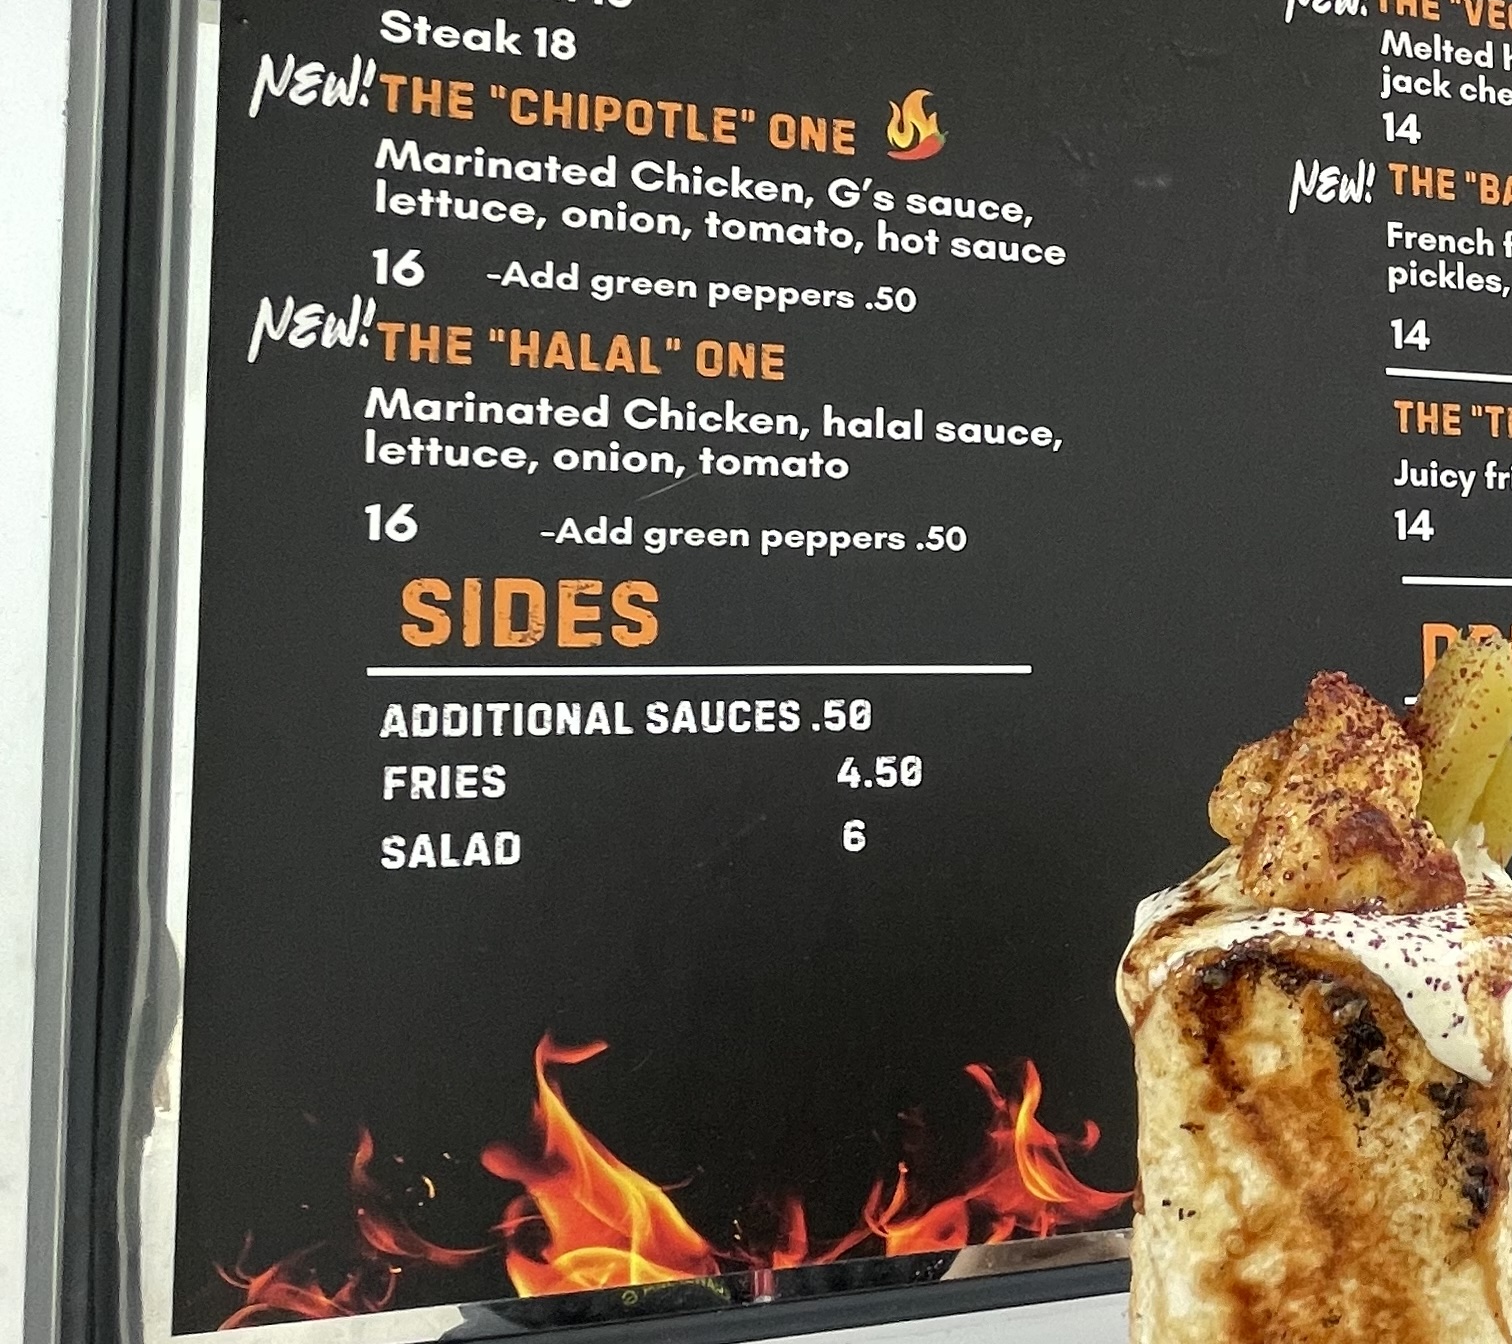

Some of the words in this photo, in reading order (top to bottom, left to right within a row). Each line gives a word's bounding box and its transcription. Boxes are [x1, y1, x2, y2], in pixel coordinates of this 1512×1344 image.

[379, 9, 522, 56] Steak
[533, 26, 577, 61] 18
[1380, 28, 1494, 69] Melted
[249, 53, 376, 119] NEW!
[379, 73, 475, 120] THE
[490, 84, 756, 145] "CHIPOTLE"
[768, 112, 856, 156] ONE
[1387, 162, 1456, 201] THE
[1393, 399, 1462, 436] THE
[1393, 458, 1477, 498] Juicy
[539, 515, 633, 546] -Add
[643, 527, 750, 554] green
[761, 529, 906, 557] peppers
[915, 525, 967, 552] .50
[1394, 508, 1435, 542] 14
[400, 577, 659, 648] SIDES
[378, 701, 634, 739] ADDITIONAL
[645, 699, 801, 735] SAUCES
[811, 698, 872, 732] .50
[382, 764, 507, 801] FRIES
[836, 755, 923, 789] 4.50
[380, 830, 521, 870] SALAD
[842, 819, 866, 852] 6
